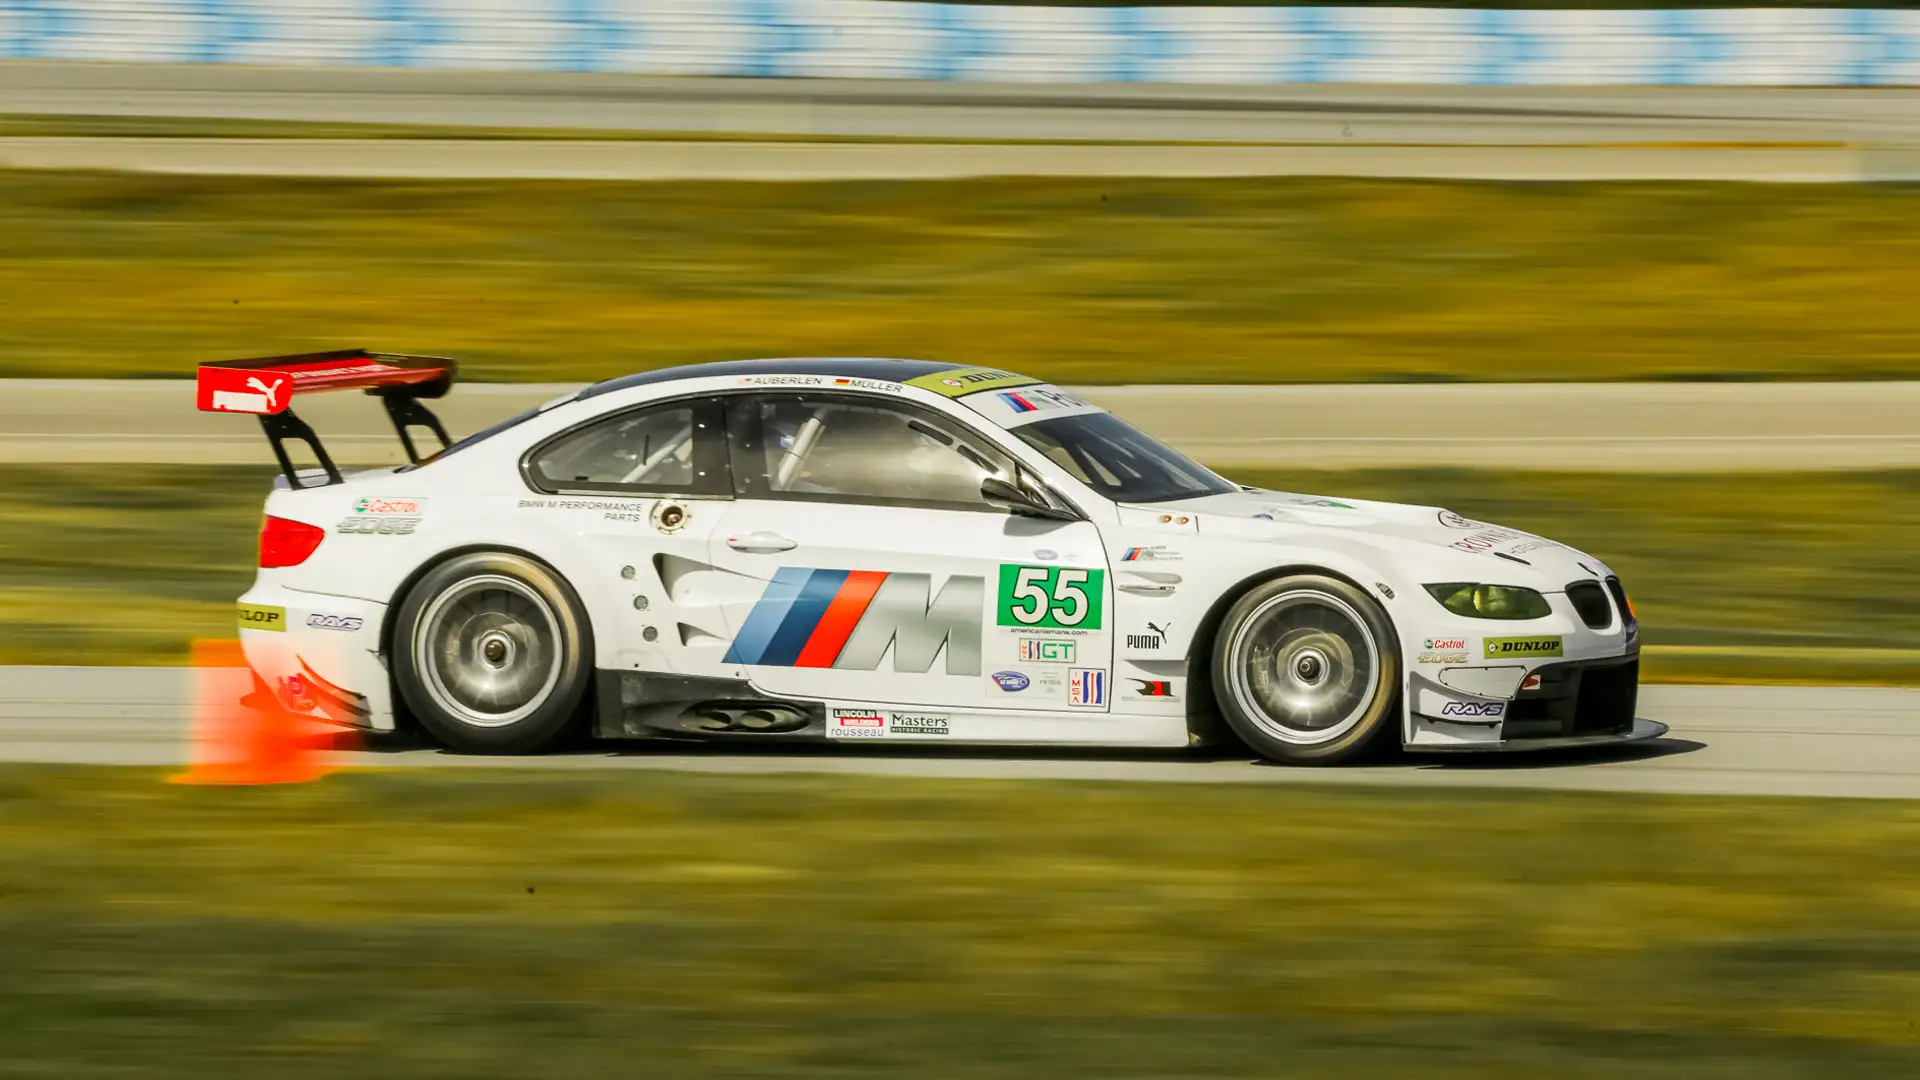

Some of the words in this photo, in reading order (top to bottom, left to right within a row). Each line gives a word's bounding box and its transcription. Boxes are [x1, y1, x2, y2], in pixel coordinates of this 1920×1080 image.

[754, 377, 823, 385] AUBERLEN
[851, 379, 903, 393] MÜLLER
[518, 500, 544, 508] BMW
[548, 500, 557, 508] M
[559, 500, 643, 512] PERFORMANCE
[604, 512, 641, 522] PARTS
[1010, 567, 1090, 626] 55
[238, 609, 280, 623] LOP
[306, 613, 364, 631] RAYS
[1126, 634, 1160, 650] PUMA
[1434, 639, 1465, 649] Castrol
[1501, 641, 1560, 652] DUNLOP
[1042, 643, 1074, 659] GT
[1071, 671, 1081, 703] IMSA
[833, 709, 876, 719] LINCOLN
[1441, 702, 1505, 715] RAYS
[891, 713, 948, 727] Masters
[830, 727, 884, 737] rousseau
